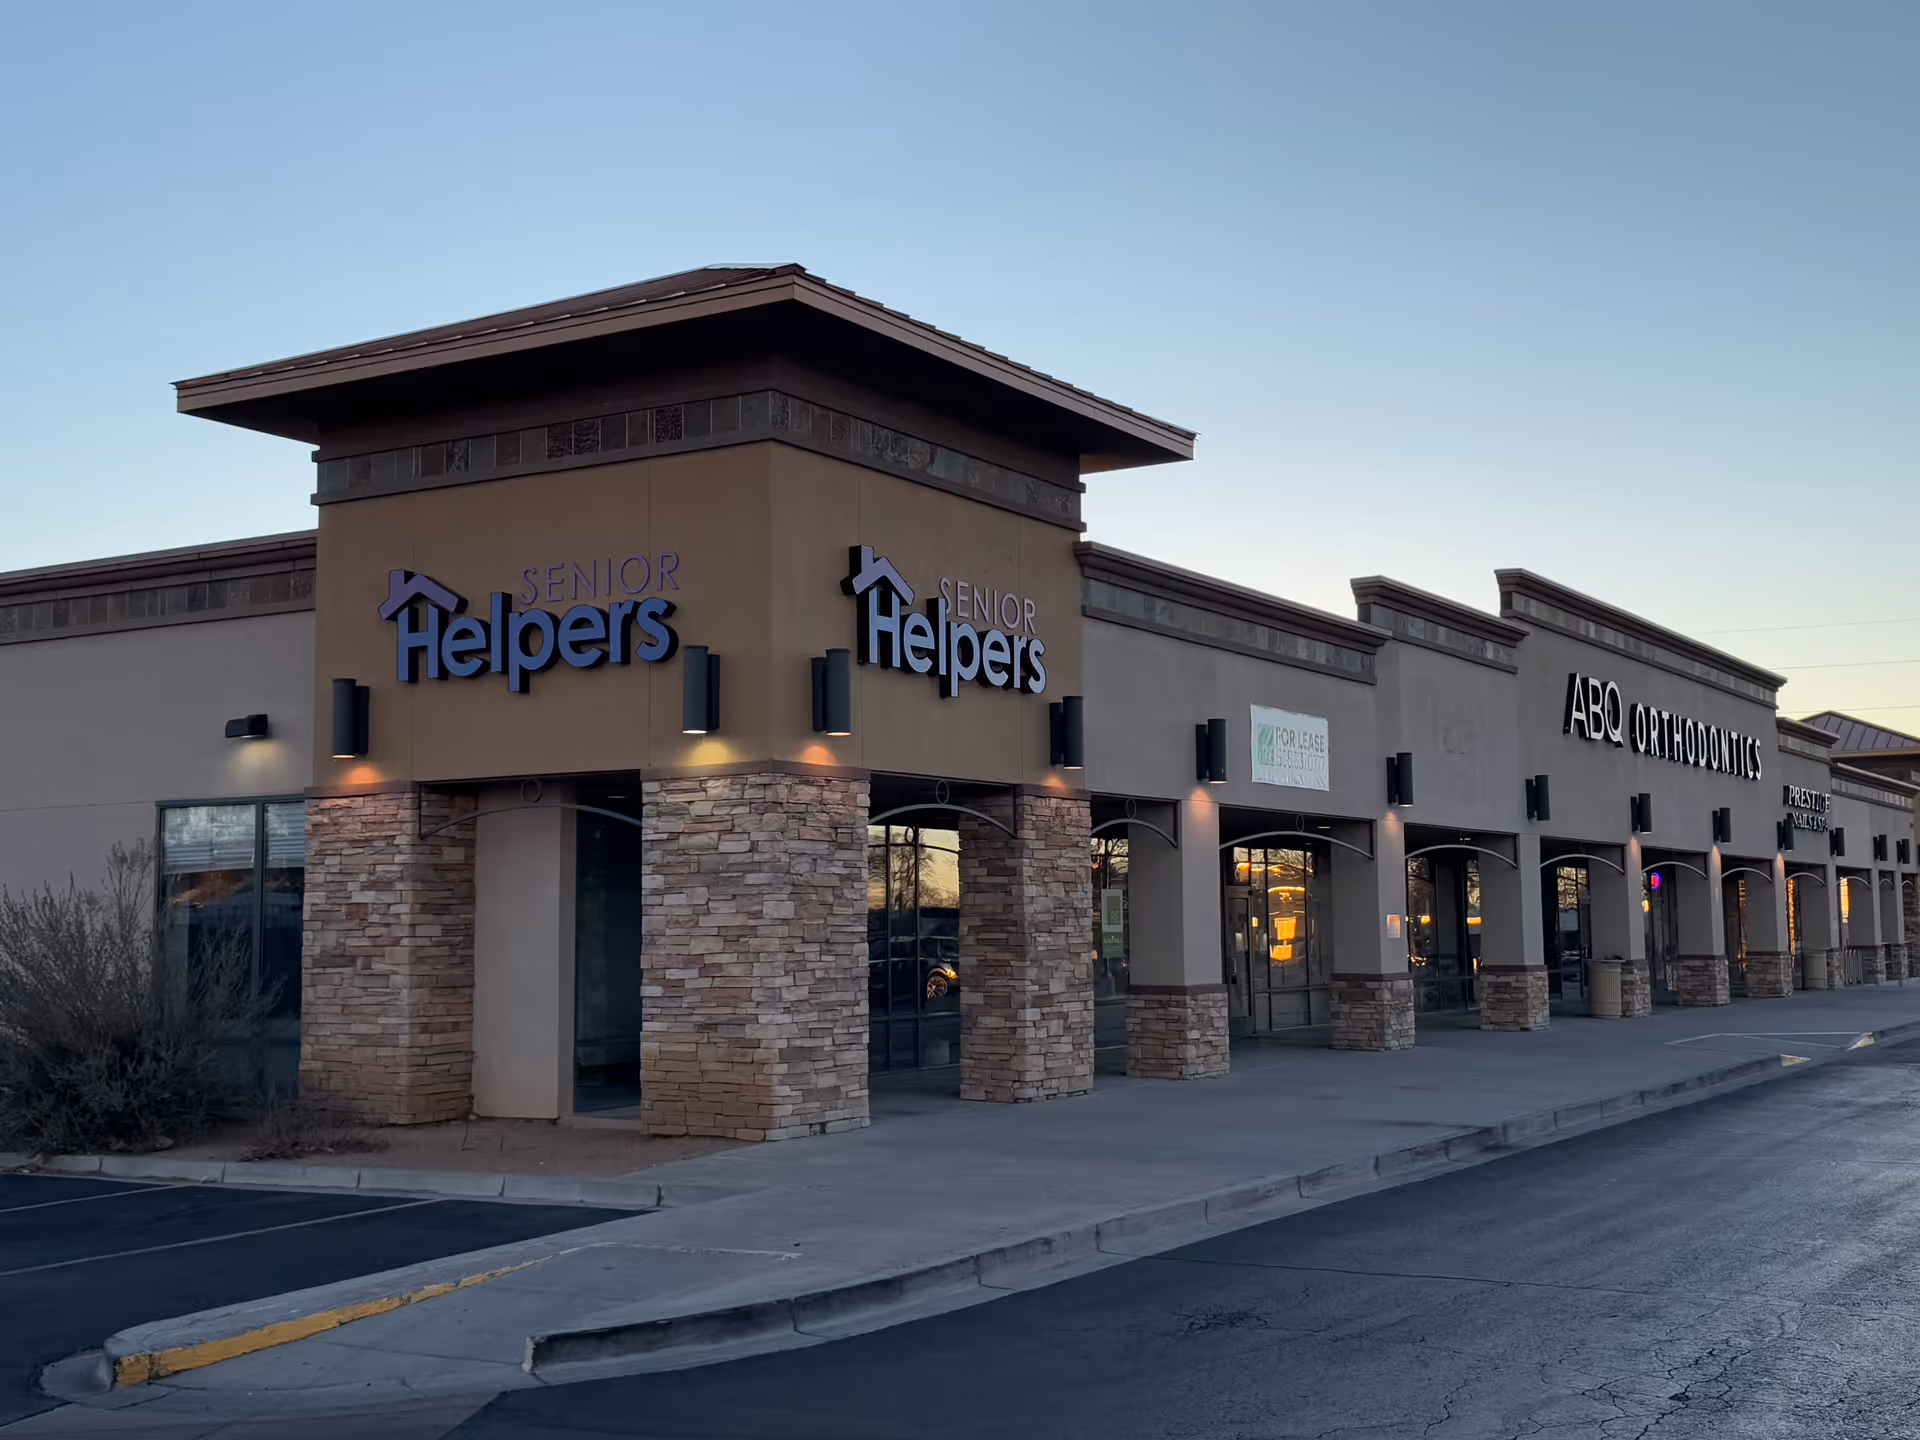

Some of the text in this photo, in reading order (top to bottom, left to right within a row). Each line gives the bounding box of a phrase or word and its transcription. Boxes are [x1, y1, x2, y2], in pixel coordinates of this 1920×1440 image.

[519, 551, 679, 605] SENIOR
[939, 576, 1037, 634] SENIOR
[397, 591, 677, 693] Helpers
[867, 585, 1047, 698] Helpers
[1276, 726, 1325, 753] FOR LEASE
[1568, 673, 1762, 781] ABQ ORTHODONTICS
[1788, 785, 1831, 813] PRESTIGE
[1792, 812, 1813, 829] NAILS
